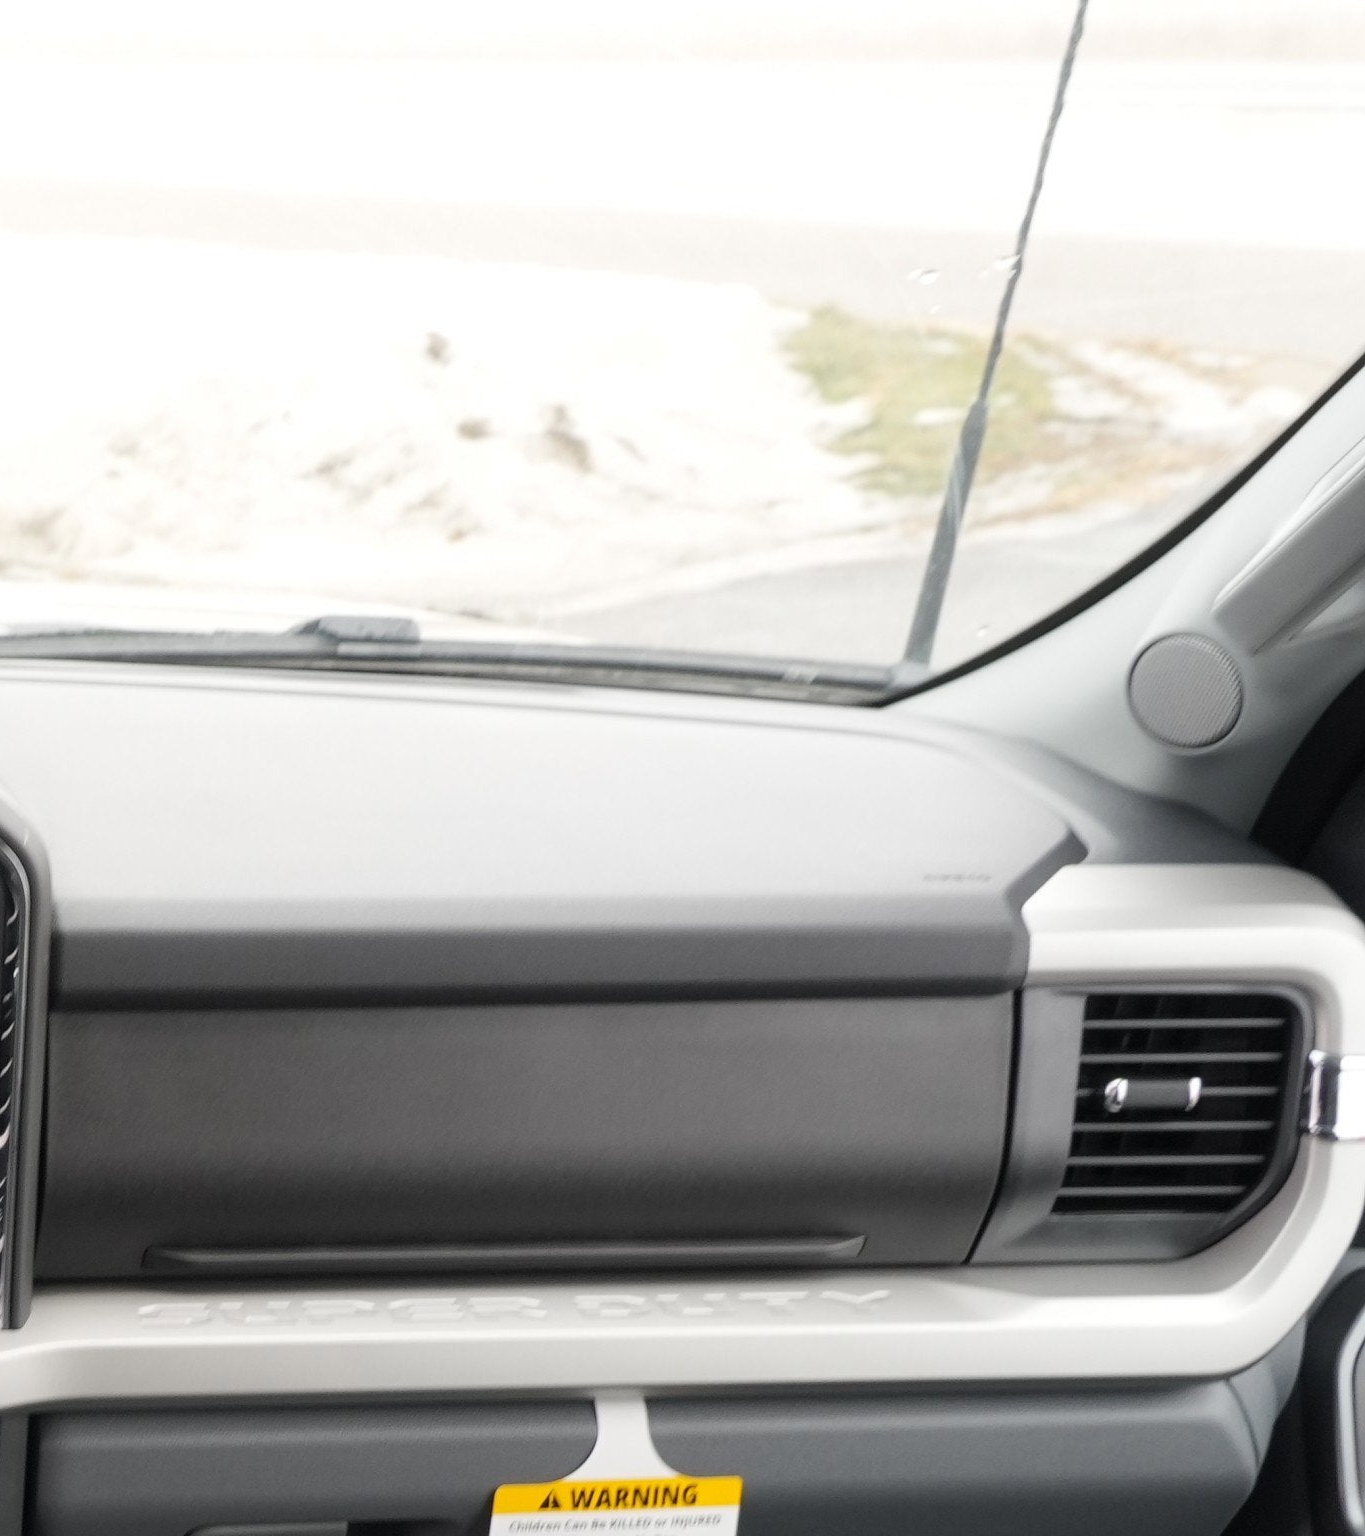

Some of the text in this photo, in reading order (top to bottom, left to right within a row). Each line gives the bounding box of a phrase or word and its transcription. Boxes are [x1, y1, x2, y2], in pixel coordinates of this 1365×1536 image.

[137, 1288, 892, 1328] SUPER DUTY
[571, 1483, 699, 1509] WARNING
[509, 1514, 722, 1533] Children Can Be KILLED or INJURED
